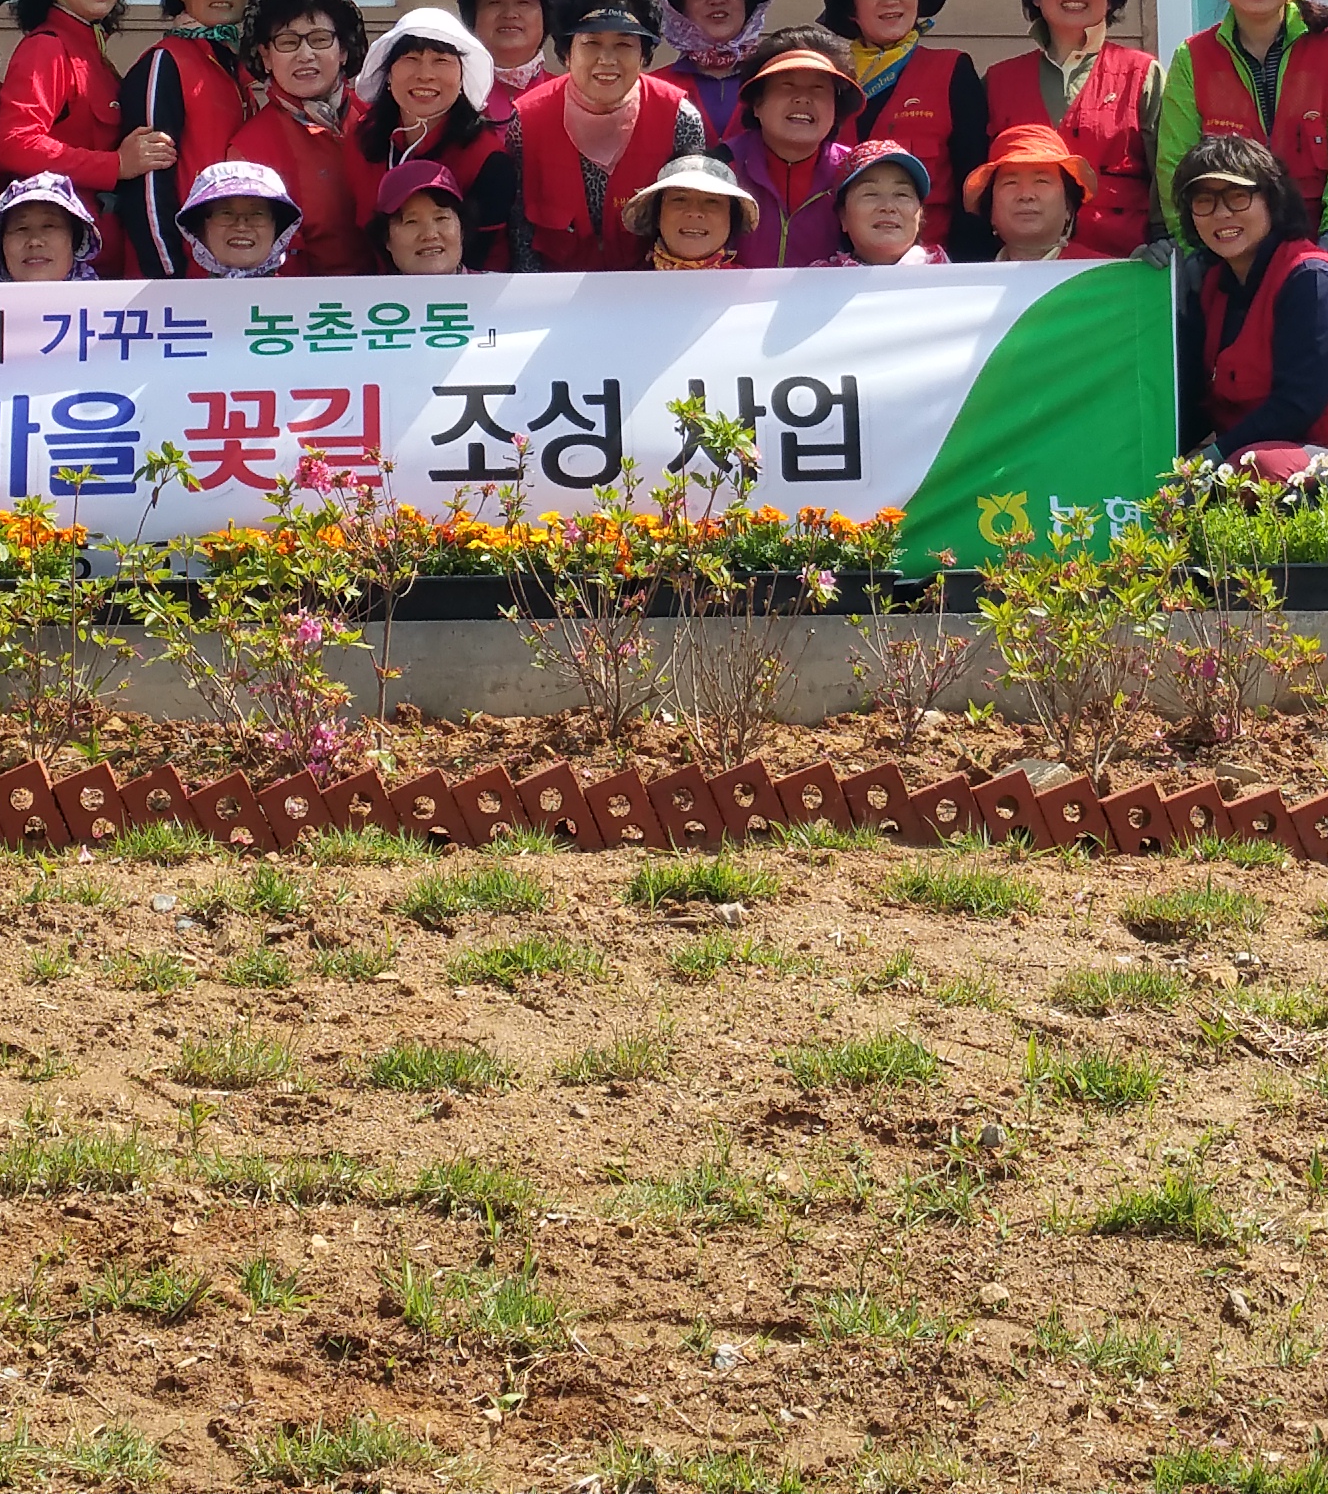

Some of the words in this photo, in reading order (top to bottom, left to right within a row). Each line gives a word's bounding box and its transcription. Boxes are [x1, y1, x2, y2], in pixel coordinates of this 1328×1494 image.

[40, 306, 213, 363] 가꾸는
[183, 383, 383, 494] 꽃길
[428, 377, 622, 489] 조성
